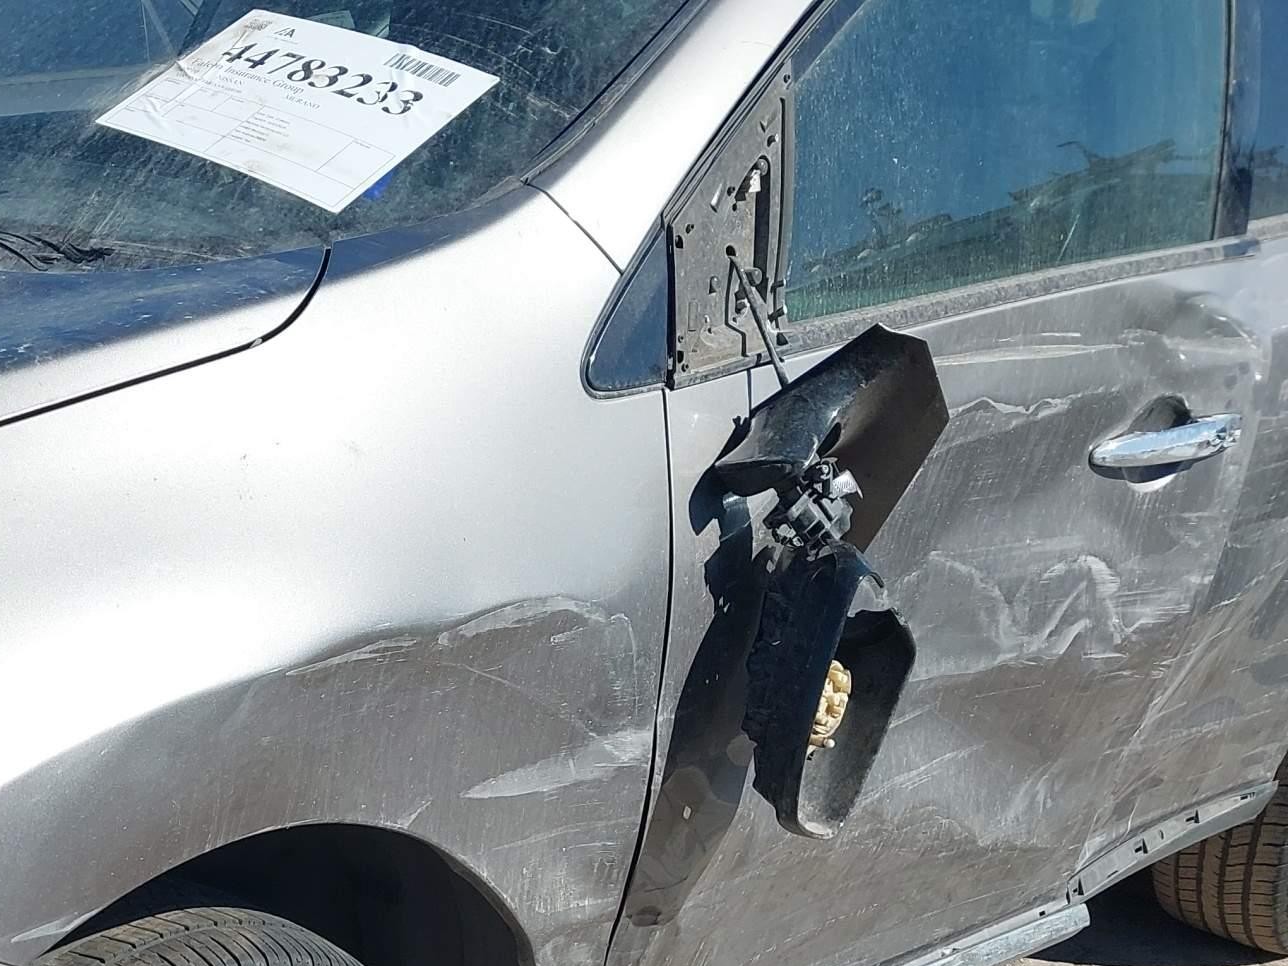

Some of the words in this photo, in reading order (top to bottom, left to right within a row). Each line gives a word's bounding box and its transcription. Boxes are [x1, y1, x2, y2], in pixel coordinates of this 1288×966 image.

[221, 43, 425, 116] 44783233
[224, 65, 272, 84] Insurance
[273, 79, 305, 97] Group
